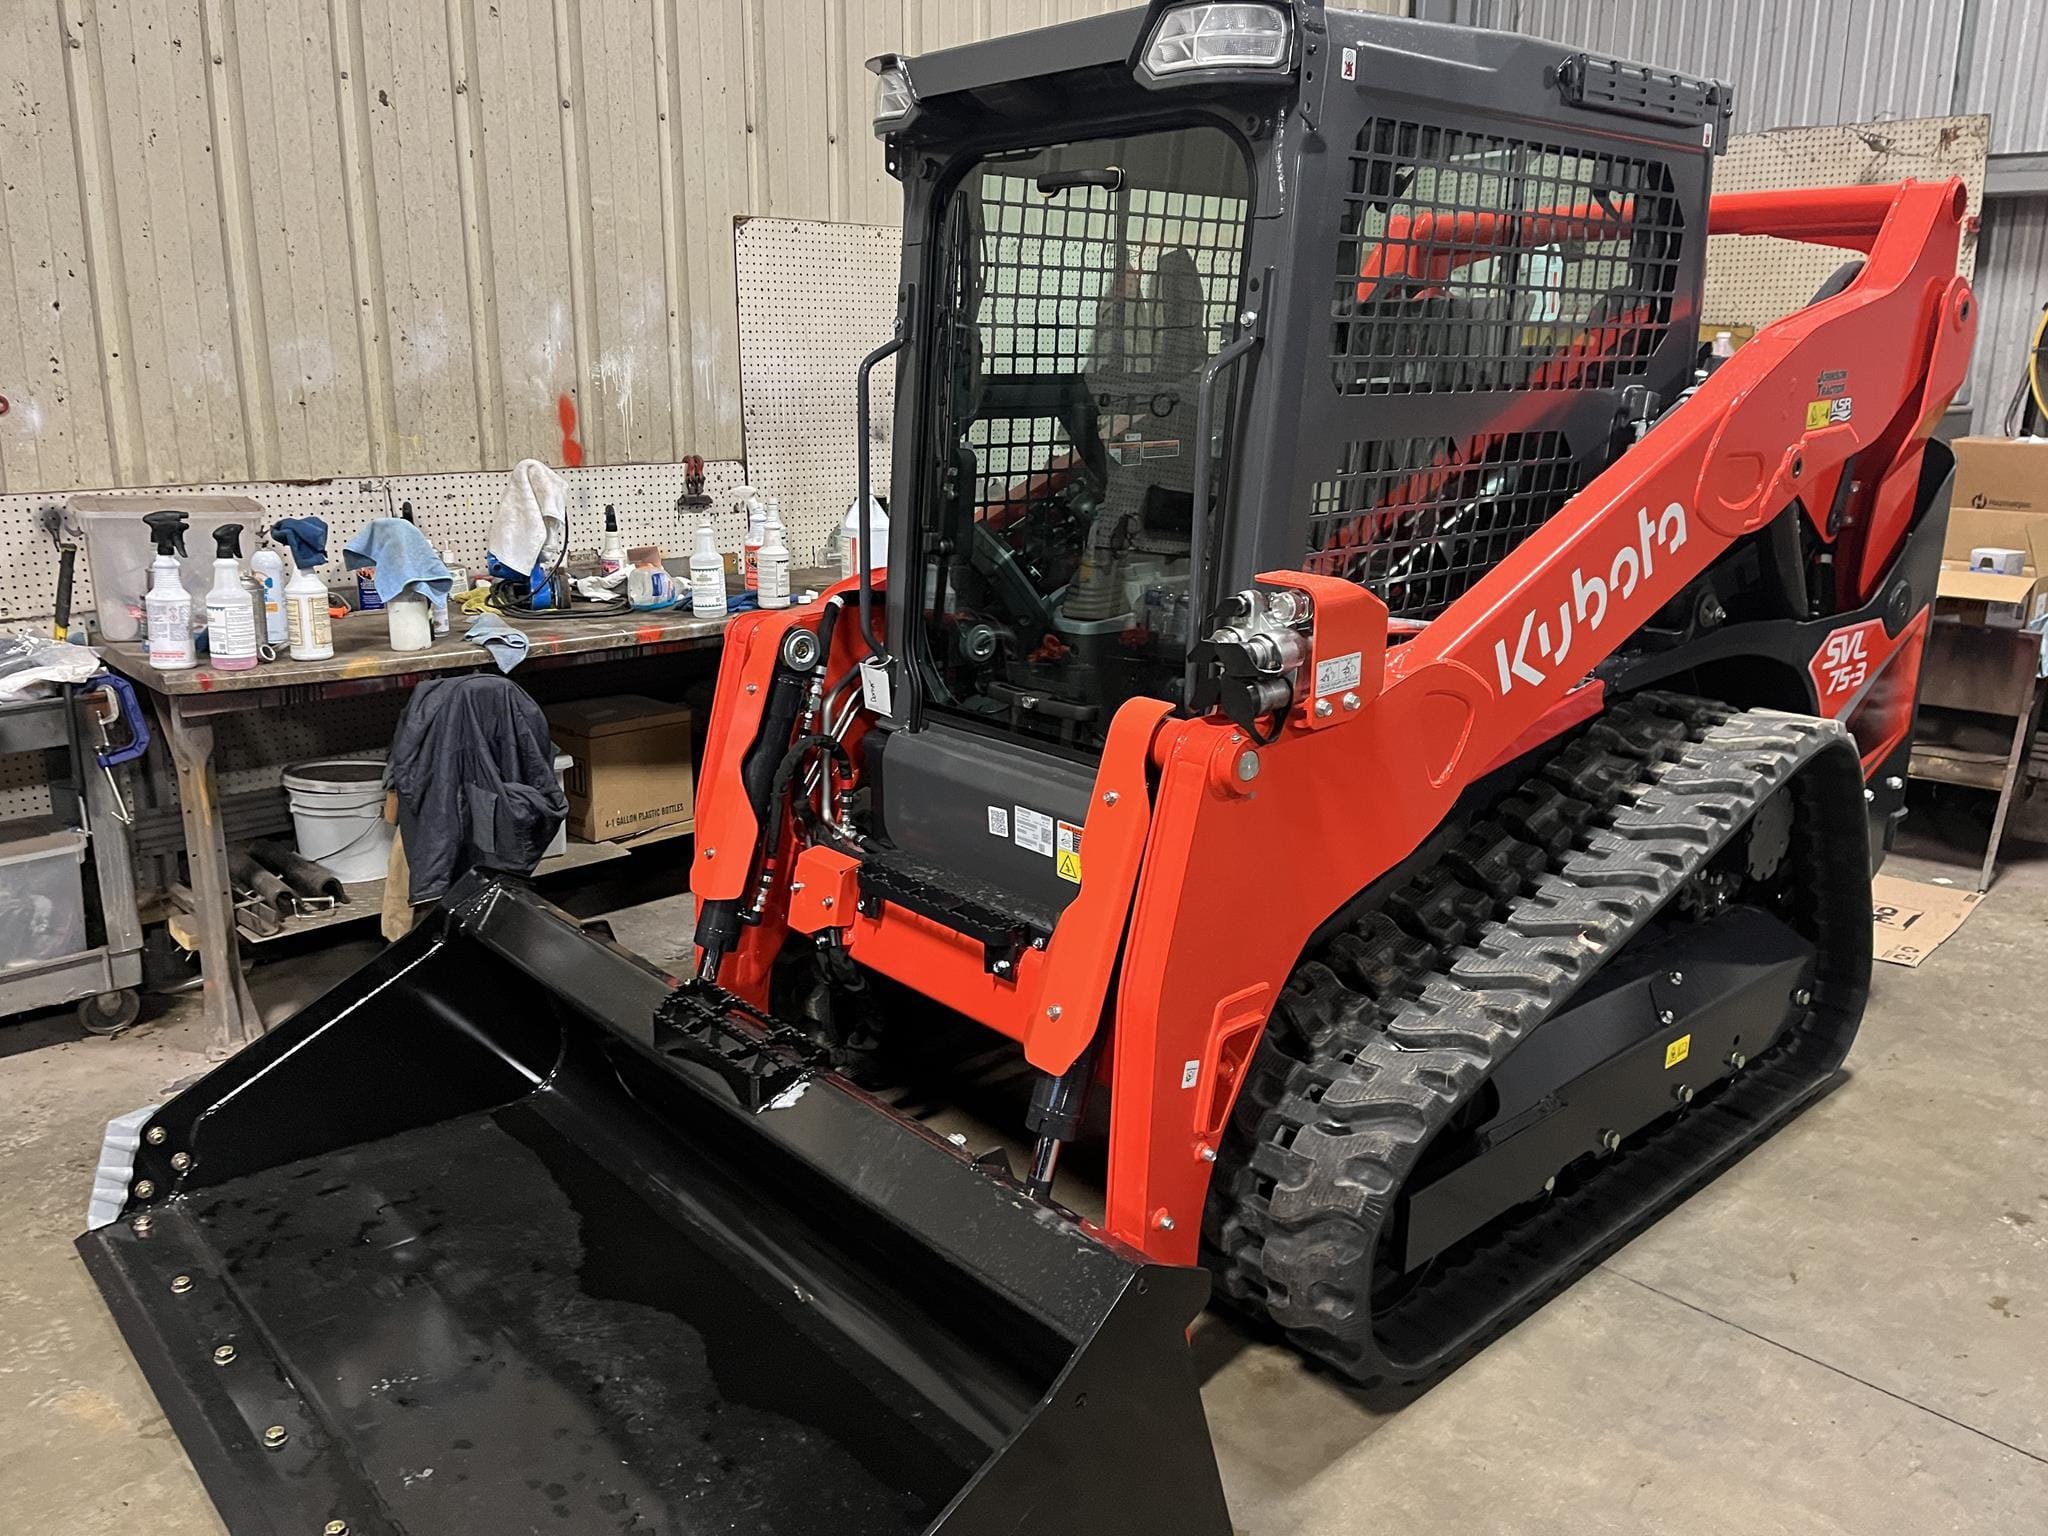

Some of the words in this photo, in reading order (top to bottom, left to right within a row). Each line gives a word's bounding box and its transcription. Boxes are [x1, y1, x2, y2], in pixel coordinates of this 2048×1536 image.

[1831, 397, 1852, 413] KSR
[1494, 502, 1688, 696] Kubota
[1822, 630, 1868, 670] SVL
[1826, 661, 1867, 696] 75-3
[616, 814, 637, 826] GALLON
[638, 809, 661, 821] PLASTIC
[661, 803, 684, 816] BOTTLES
